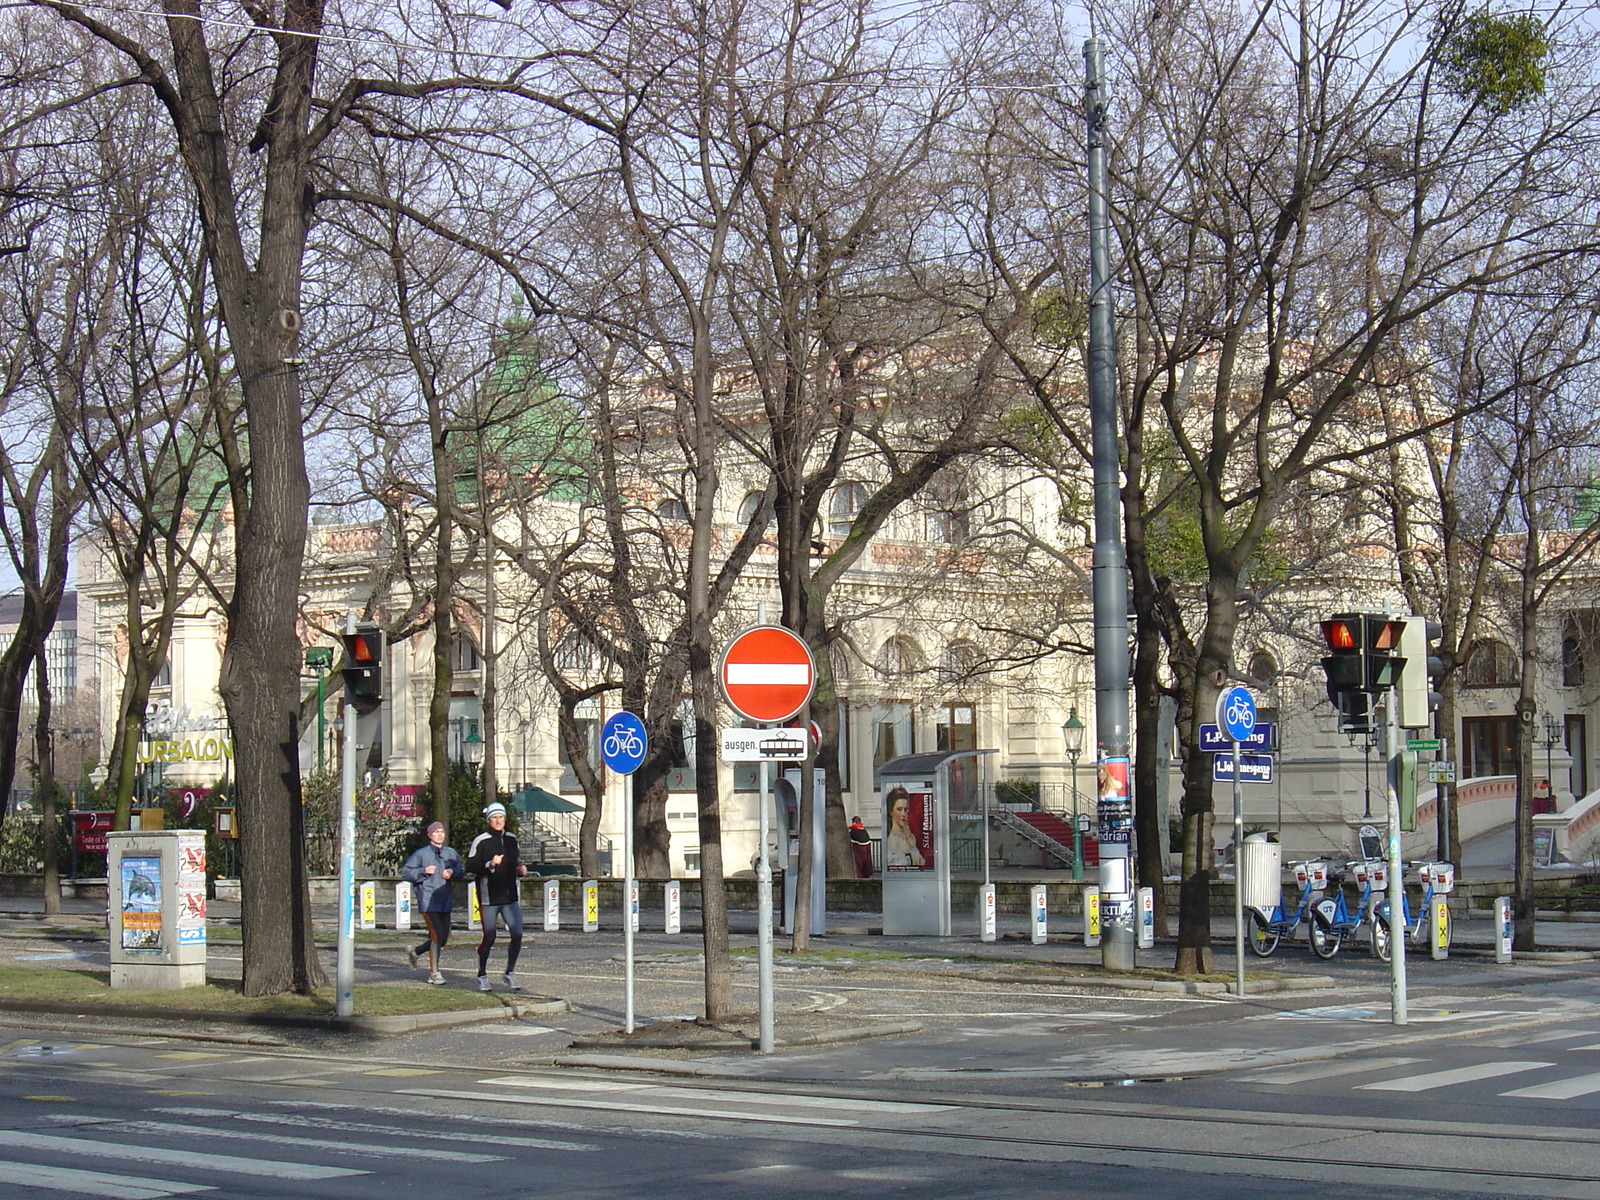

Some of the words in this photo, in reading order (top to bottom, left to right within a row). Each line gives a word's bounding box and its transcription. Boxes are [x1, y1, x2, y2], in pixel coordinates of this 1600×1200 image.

[136, 739, 233, 763] URSALON
[725, 741, 758, 753] ausgen.
[922, 794, 930, 831] Museum
